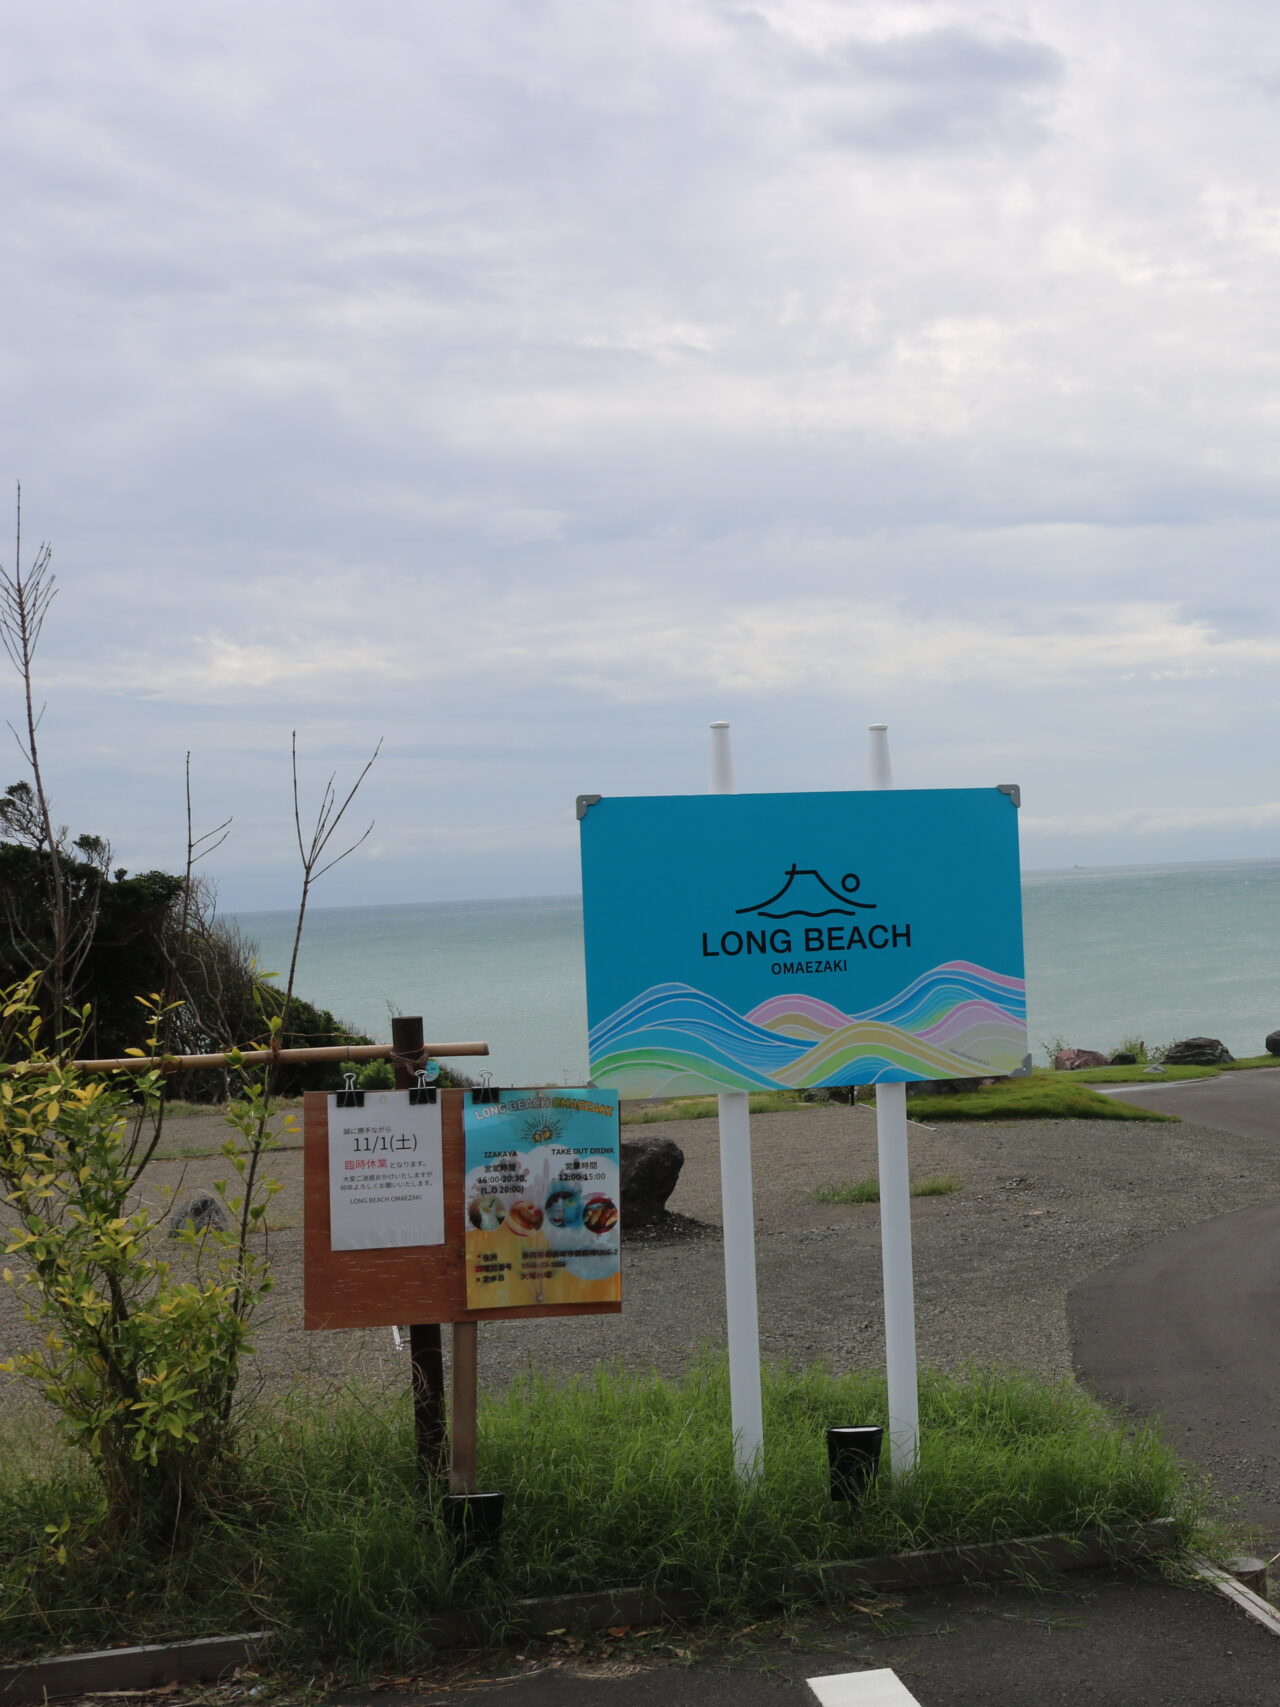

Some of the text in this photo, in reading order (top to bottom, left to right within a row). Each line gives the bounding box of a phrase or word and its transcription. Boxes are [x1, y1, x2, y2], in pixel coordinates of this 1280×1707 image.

[702, 923, 912, 957] LONG BEACH
[771, 959, 848, 975] OMAEZAKI
[474, 1096, 615, 1120] LONG BEACH OMAEZAKI
[343, 1126, 392, 1135] 誠に勝手ながら
[353, 1133, 418, 1153] 11/1(土)
[484, 1150, 518, 1158] IZAKAYA
[573, 1147, 588, 1155] OUT
[590, 1146, 615, 1154] DRINK
[368, 1196, 390, 1204] BEACH
[390, 1194, 422, 1202] OMAEZAKI
